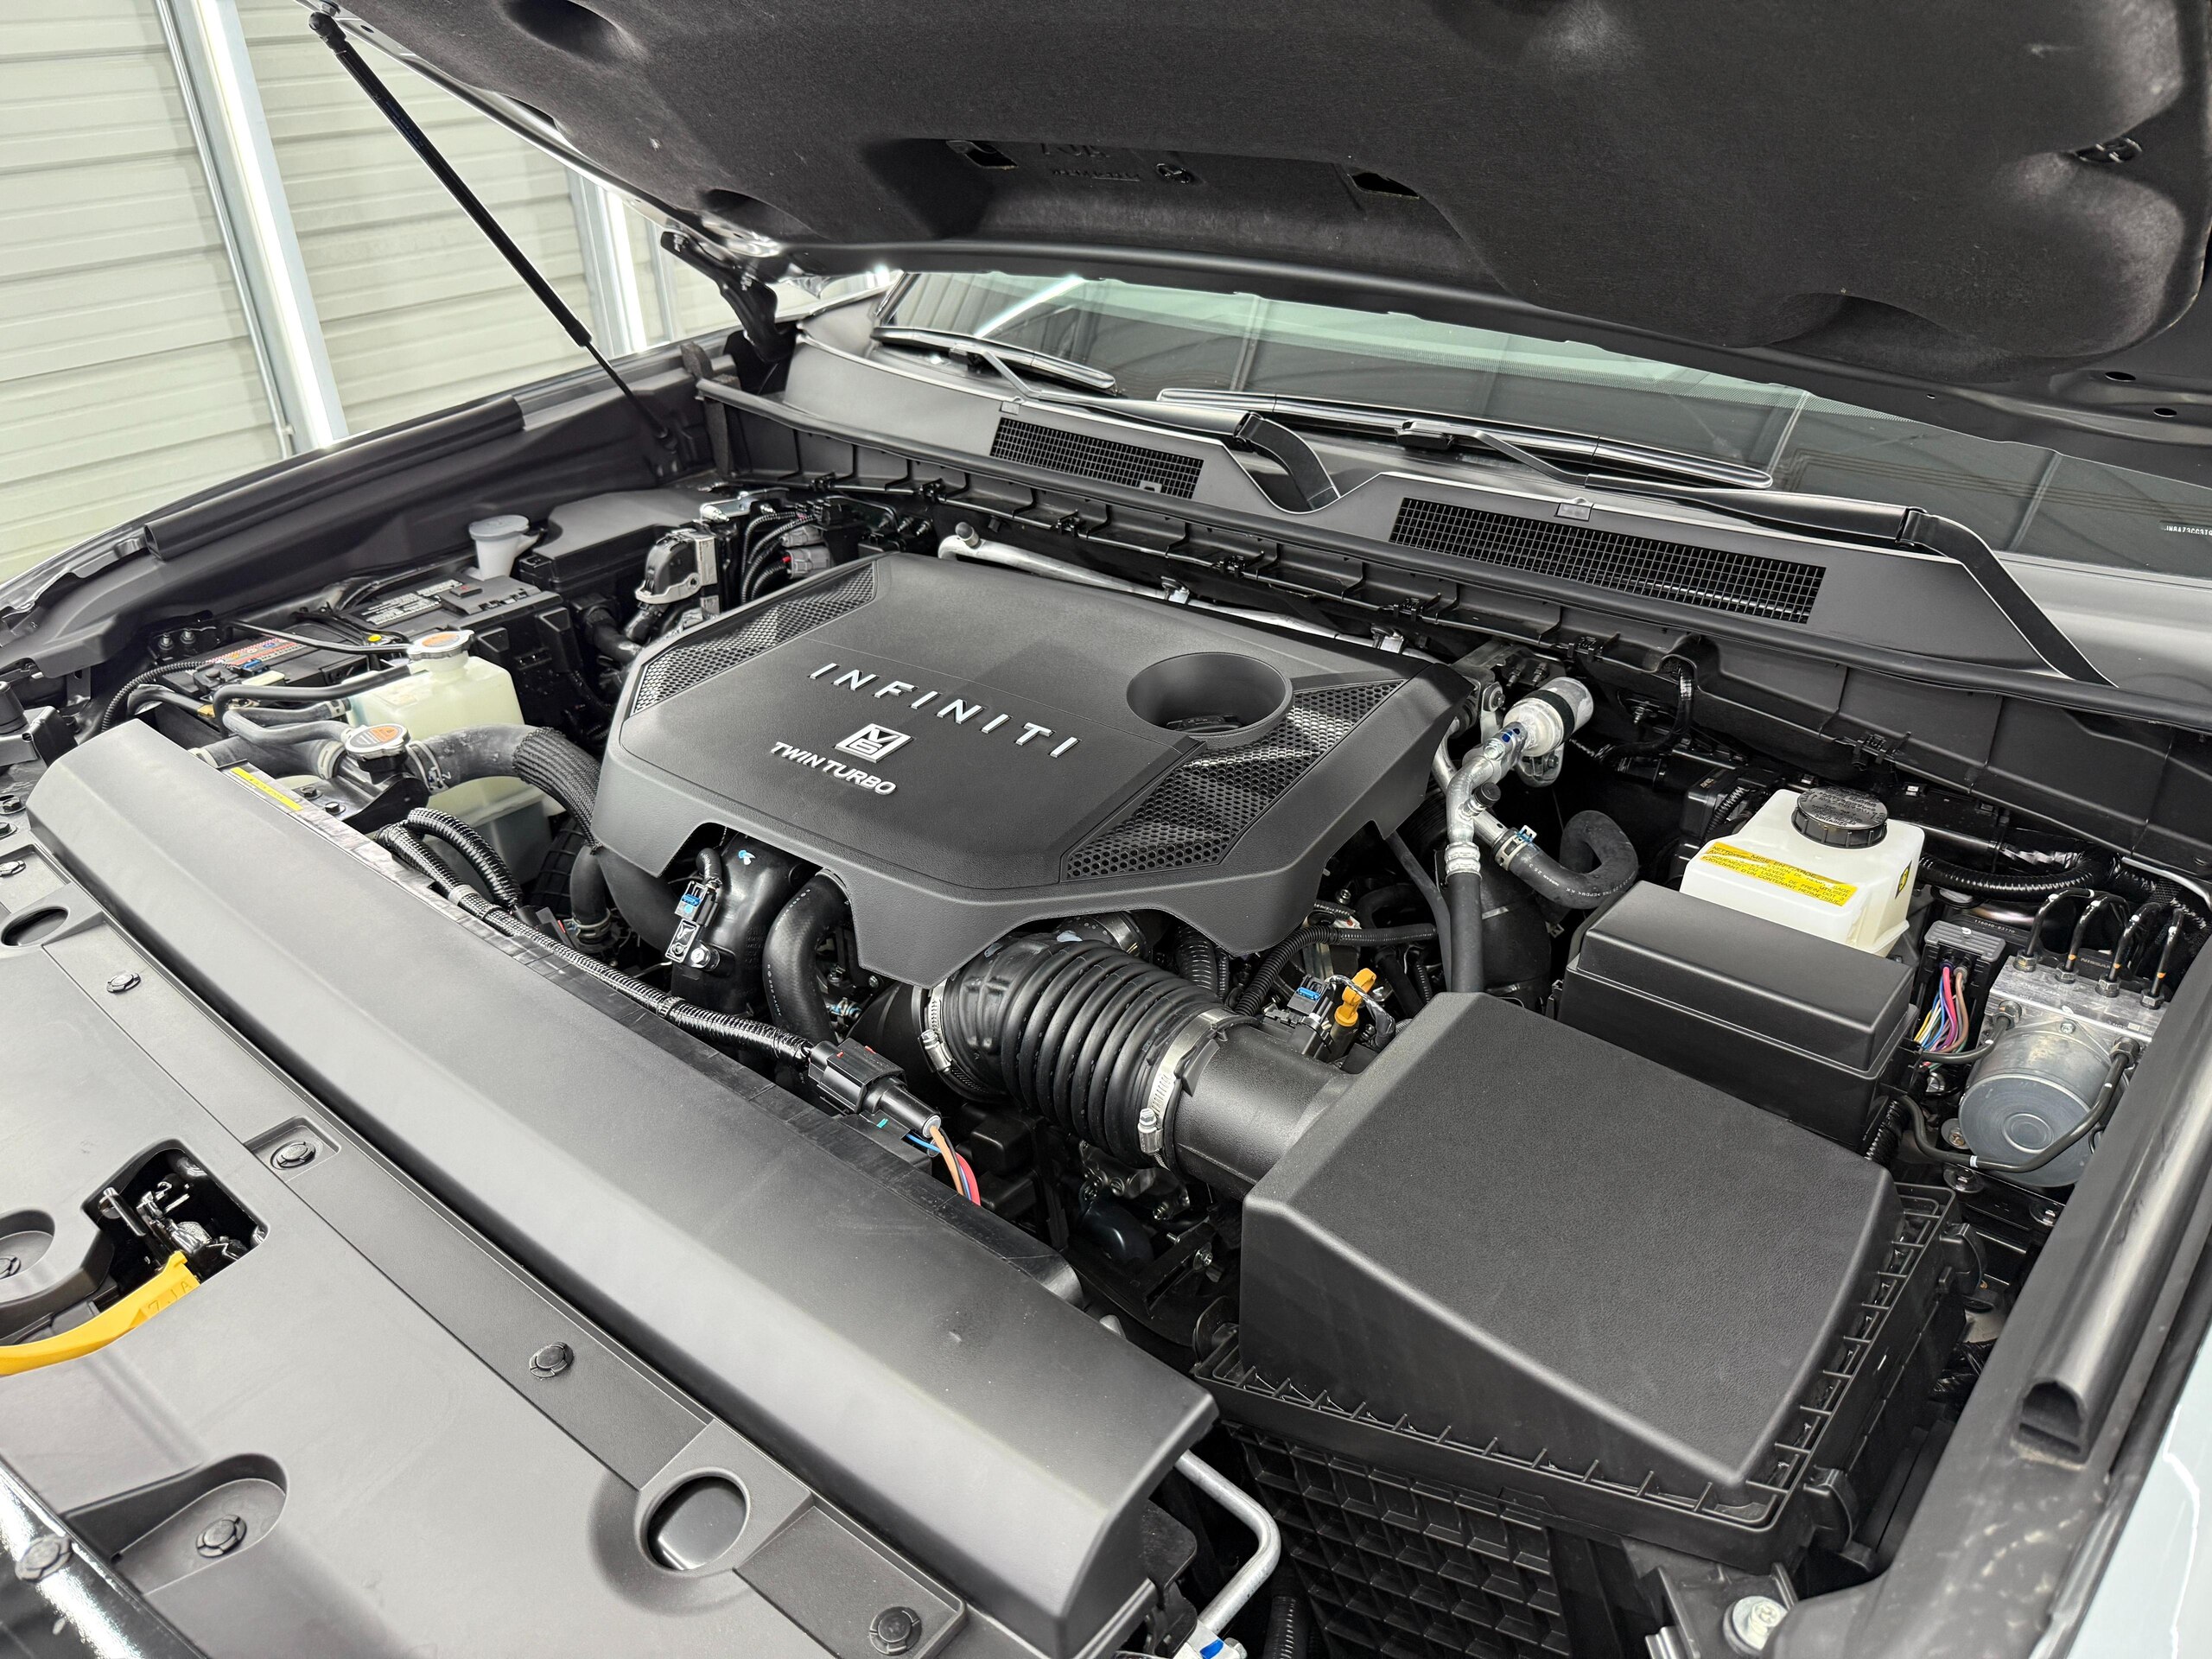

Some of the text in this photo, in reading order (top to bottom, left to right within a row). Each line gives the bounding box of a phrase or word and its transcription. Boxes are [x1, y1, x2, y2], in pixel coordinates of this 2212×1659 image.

[810, 662, 1079, 758] INFINITI
[770, 741, 897, 796] TWIN TURBO
